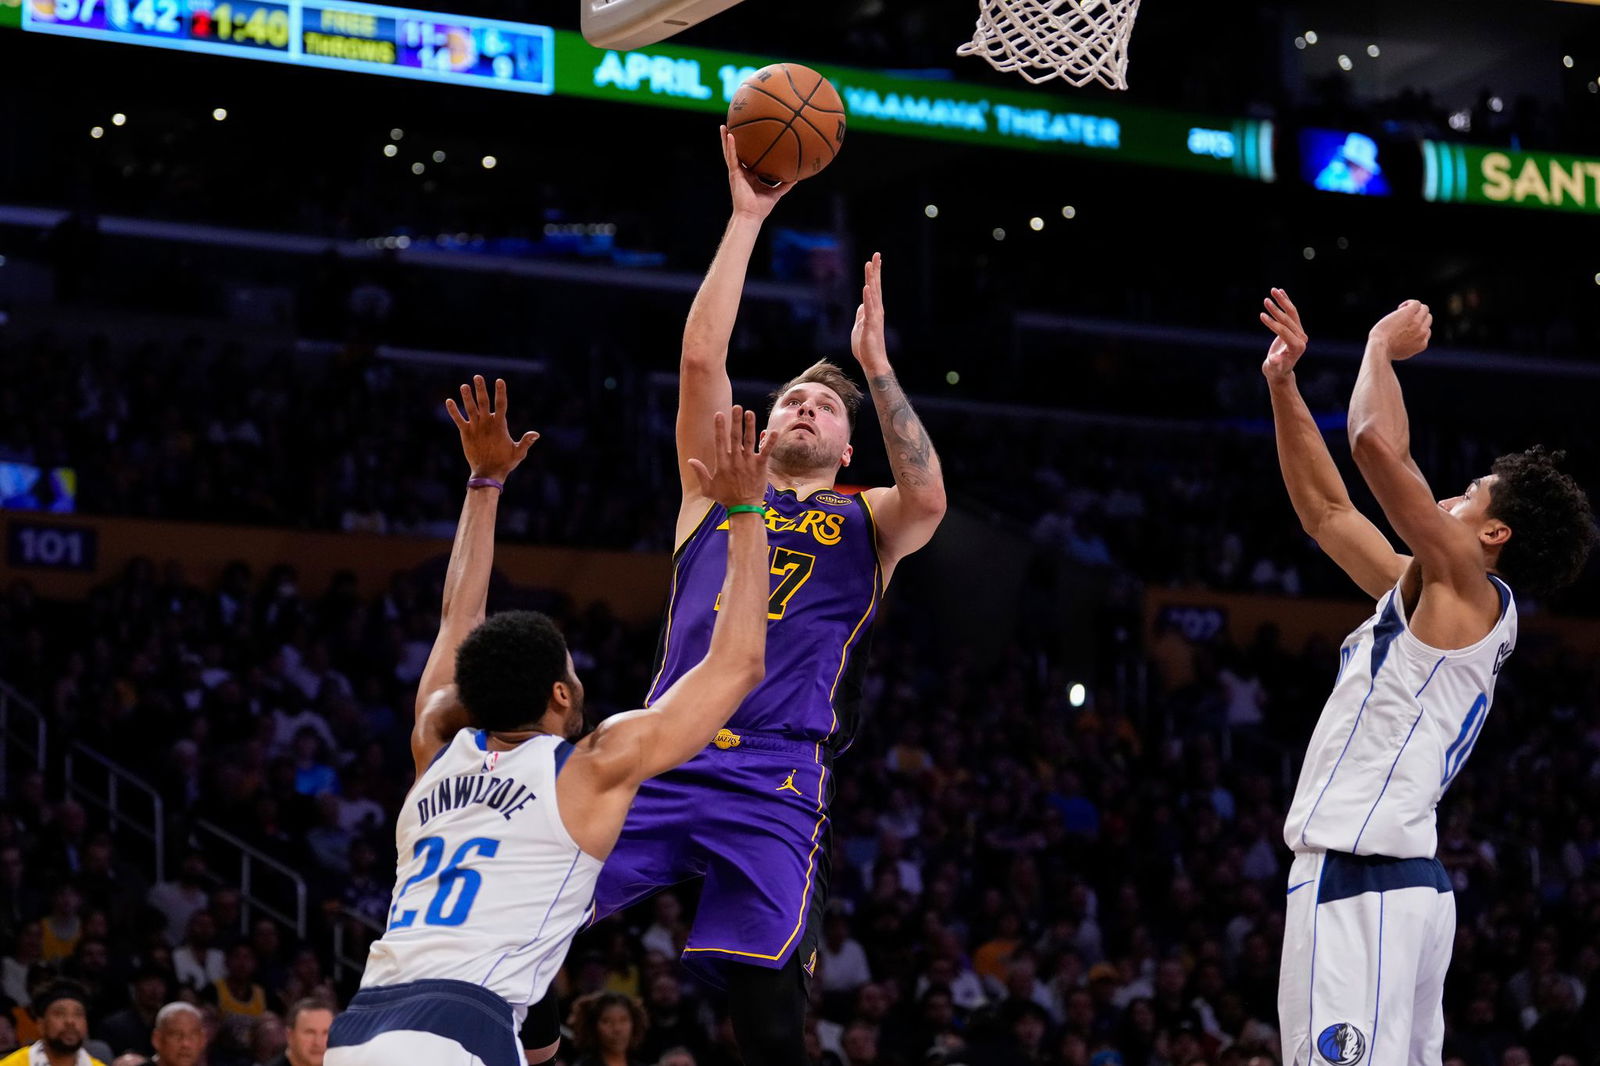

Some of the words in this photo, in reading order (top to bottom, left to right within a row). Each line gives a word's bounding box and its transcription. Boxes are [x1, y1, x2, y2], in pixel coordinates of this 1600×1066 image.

[212, 4, 288, 47] 1:40
[321, 8, 376, 37] FREE
[305, 30, 394, 64] THROWS
[593, 49, 712, 99] APRIL
[994, 104, 1120, 148] THEATER
[20, 528, 83, 565] 101
[388, 836, 501, 931] 26
